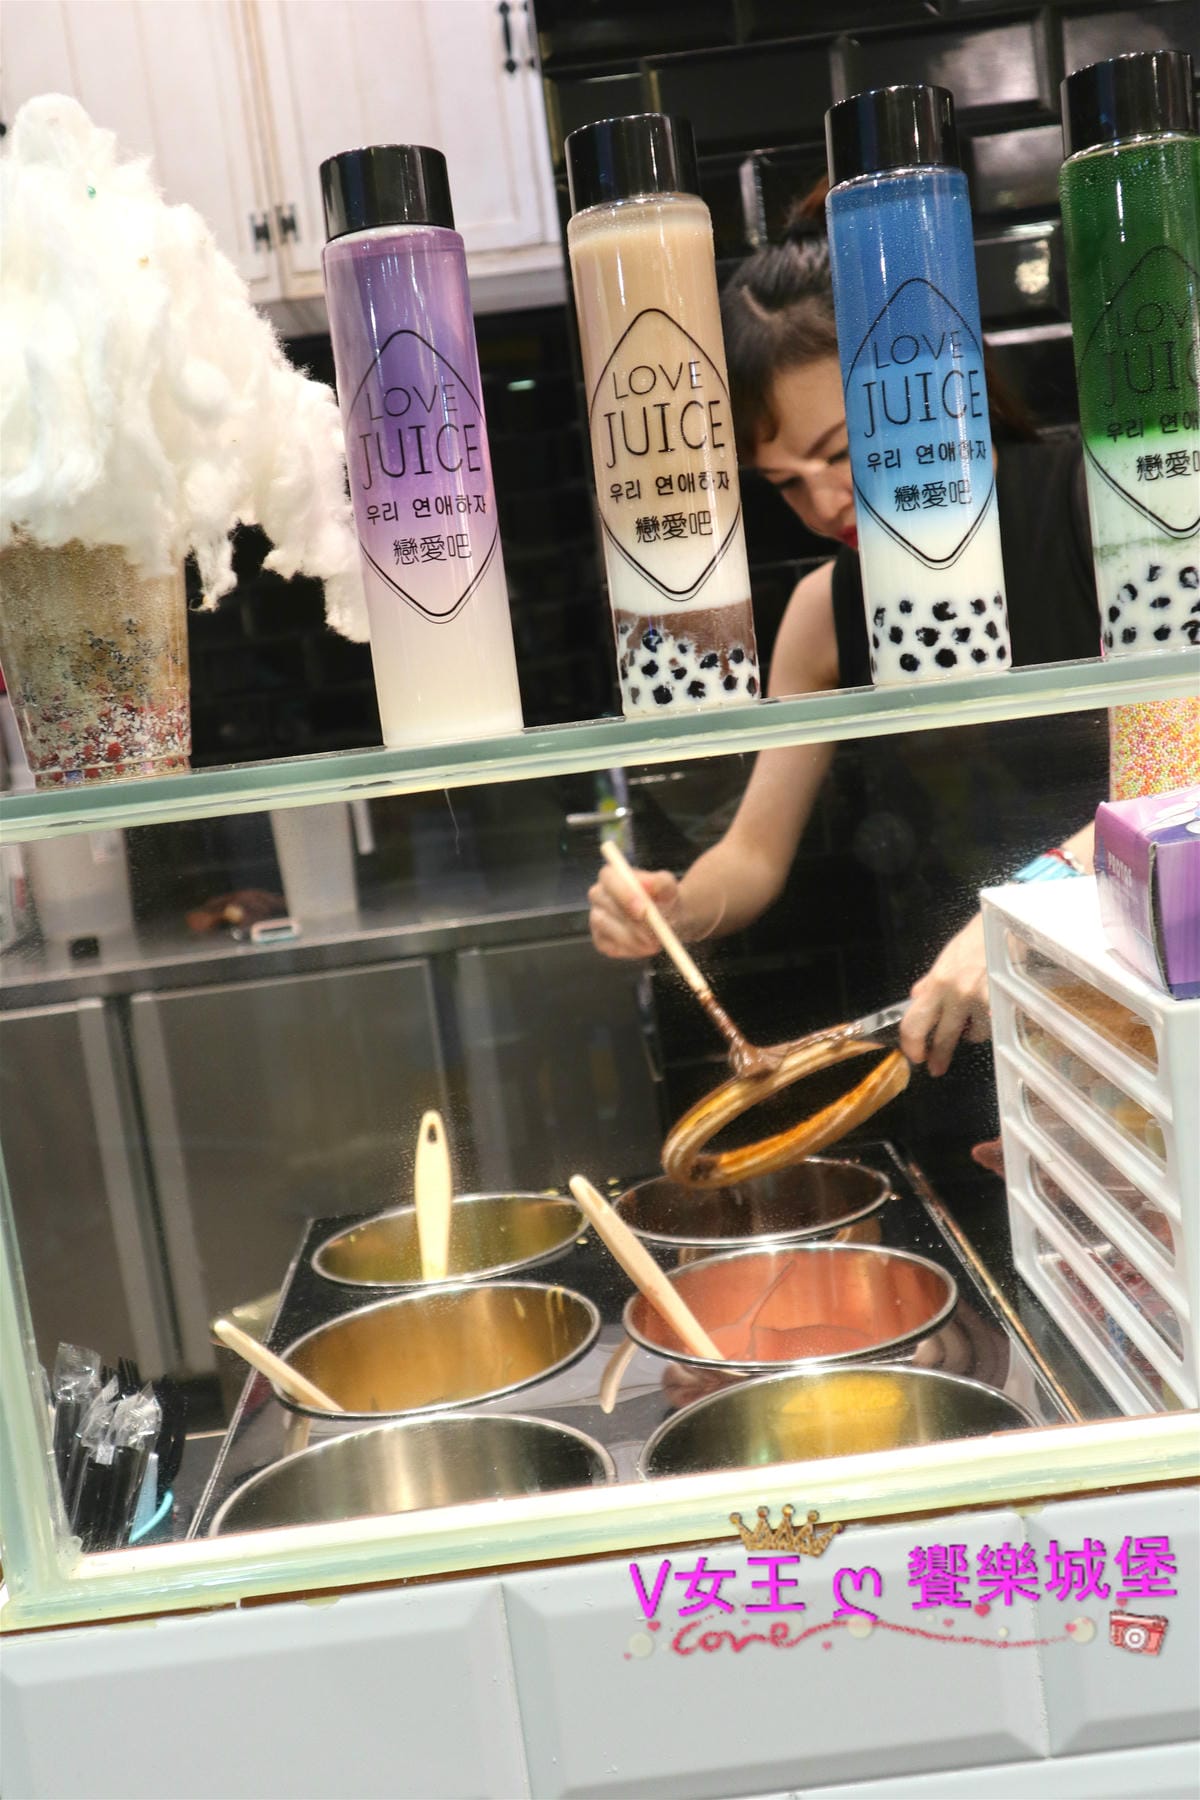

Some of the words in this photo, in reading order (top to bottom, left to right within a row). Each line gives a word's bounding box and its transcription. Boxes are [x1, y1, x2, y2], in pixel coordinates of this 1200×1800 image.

[874, 330, 964, 368] LOVE
[613, 361, 703, 399] LOVE
[367, 384, 457, 420] LOVE
[863, 370, 982, 438] JUICE
[604, 400, 725, 468] JUICE
[1106, 418, 1144, 442] 우리
[360, 424, 481, 490] JUICE
[867, 449, 901, 473] 우리
[610, 480, 641, 503] 우리
[655, 470, 729, 495] 연애하자
[894, 479, 972, 512] 戀愛吧
[367, 501, 399, 525] 우리
[412, 494, 486, 518] 연애하자
[635, 510, 713, 543] 戀愛吧
[393, 533, 472, 565] 戀愛吧
